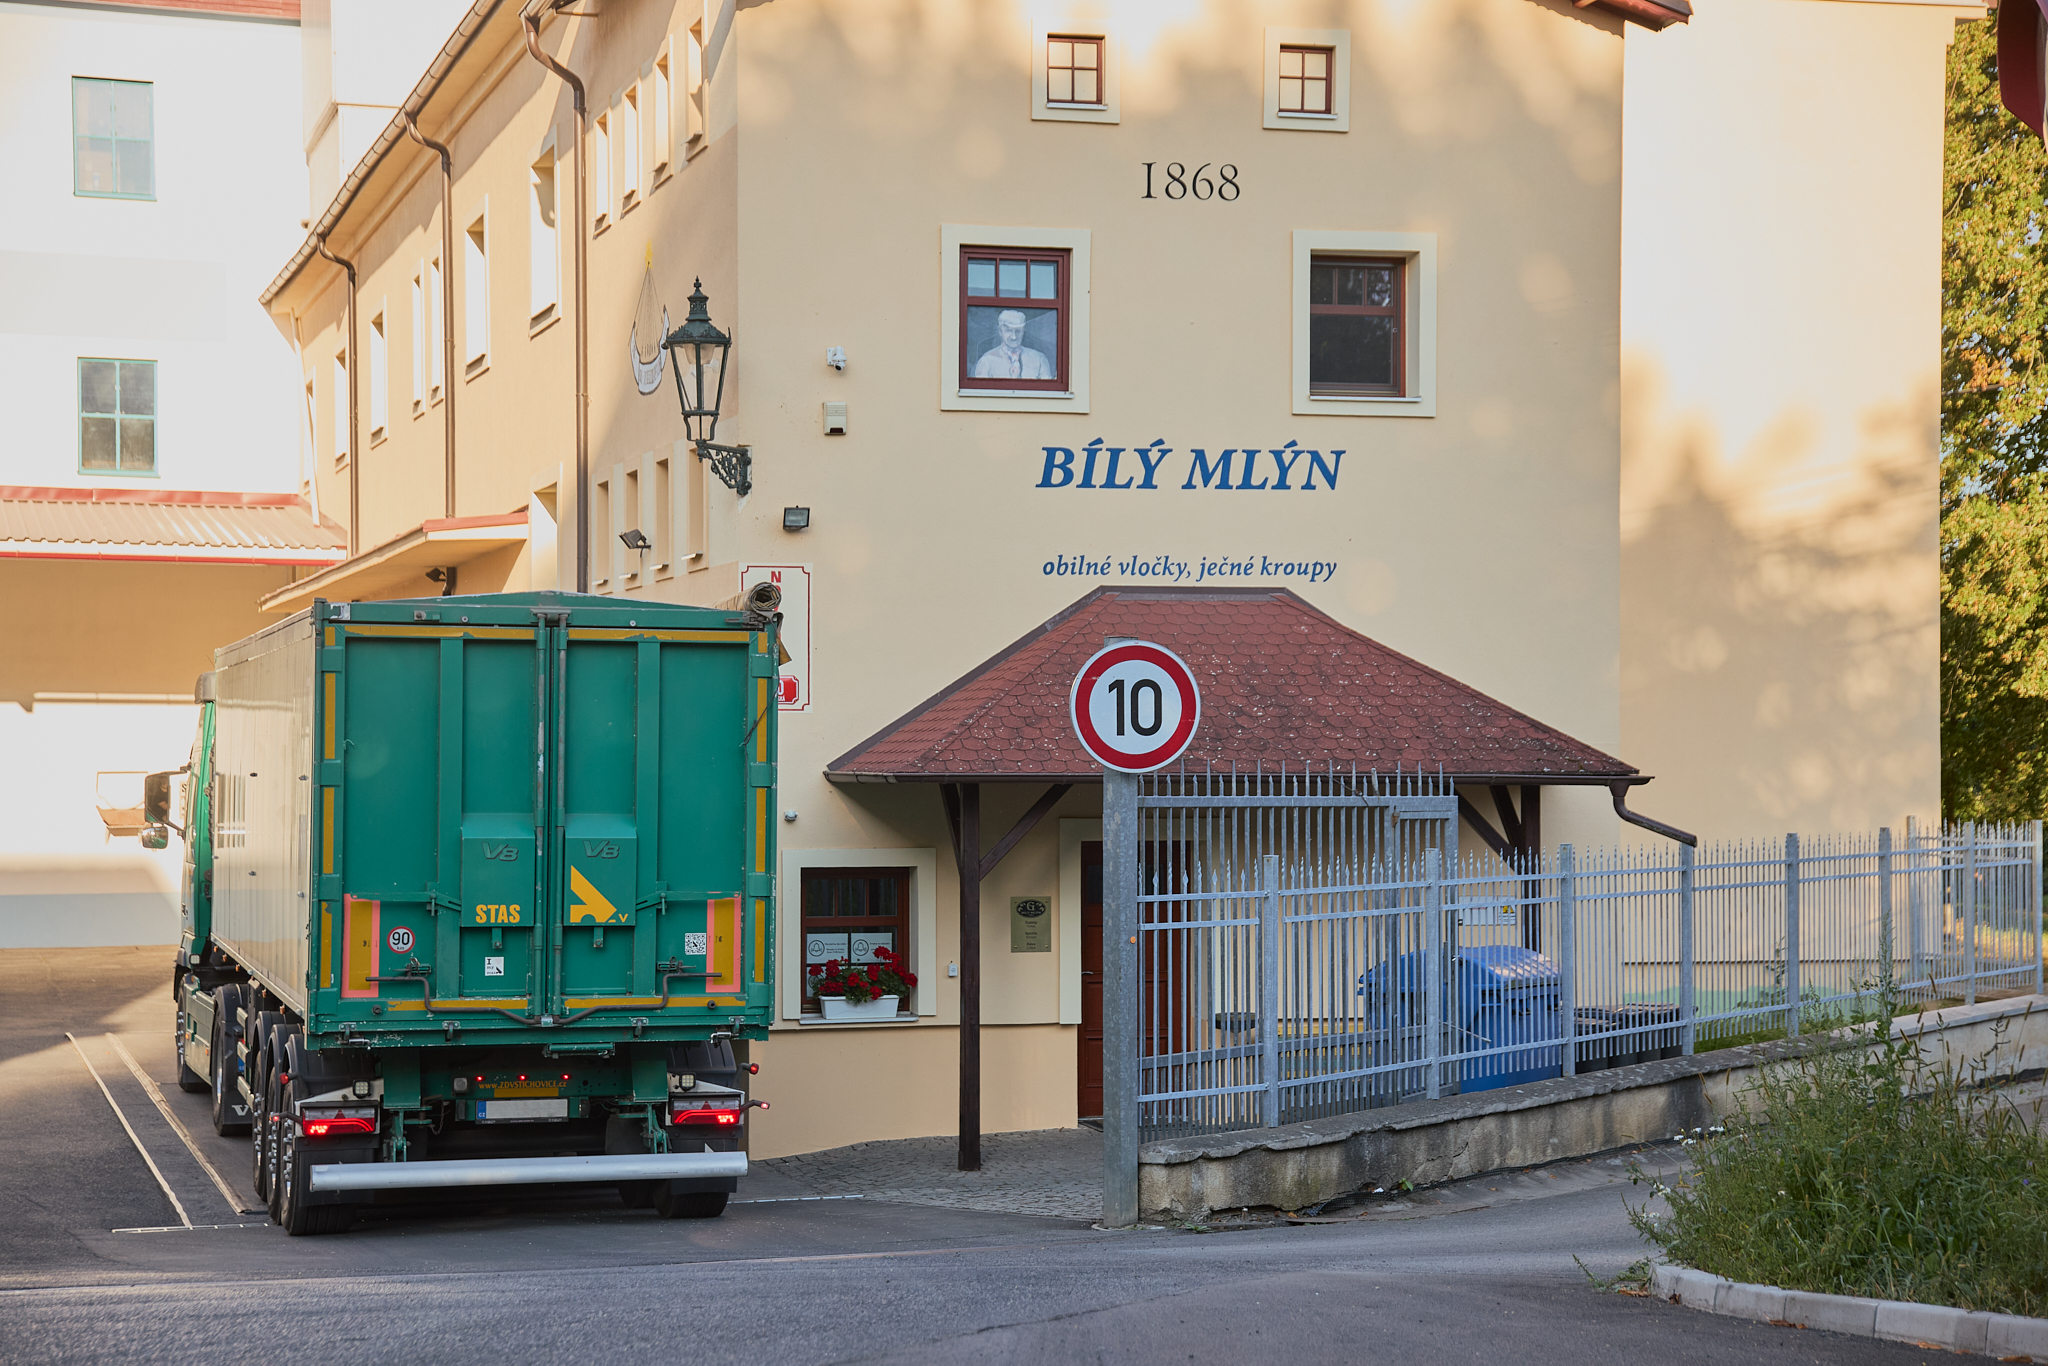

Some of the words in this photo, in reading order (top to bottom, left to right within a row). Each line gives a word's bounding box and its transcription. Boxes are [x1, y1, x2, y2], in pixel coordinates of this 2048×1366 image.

[1141, 162, 1240, 201] 1868
[1035, 437, 1173, 490] BÍLÝ
[1181, 439, 1346, 490] MLÝN
[1042, 555, 1111, 576] obilné
[1118, 555, 1191, 580] vločky,
[1196, 556, 1254, 582] ječné
[1260, 556, 1337, 582] kroupy
[1108, 678, 1163, 737] 10
[481, 841, 519, 861] V8
[582, 839, 620, 859] V8
[475, 904, 521, 924] STAS
[392, 931, 410, 946] 90
